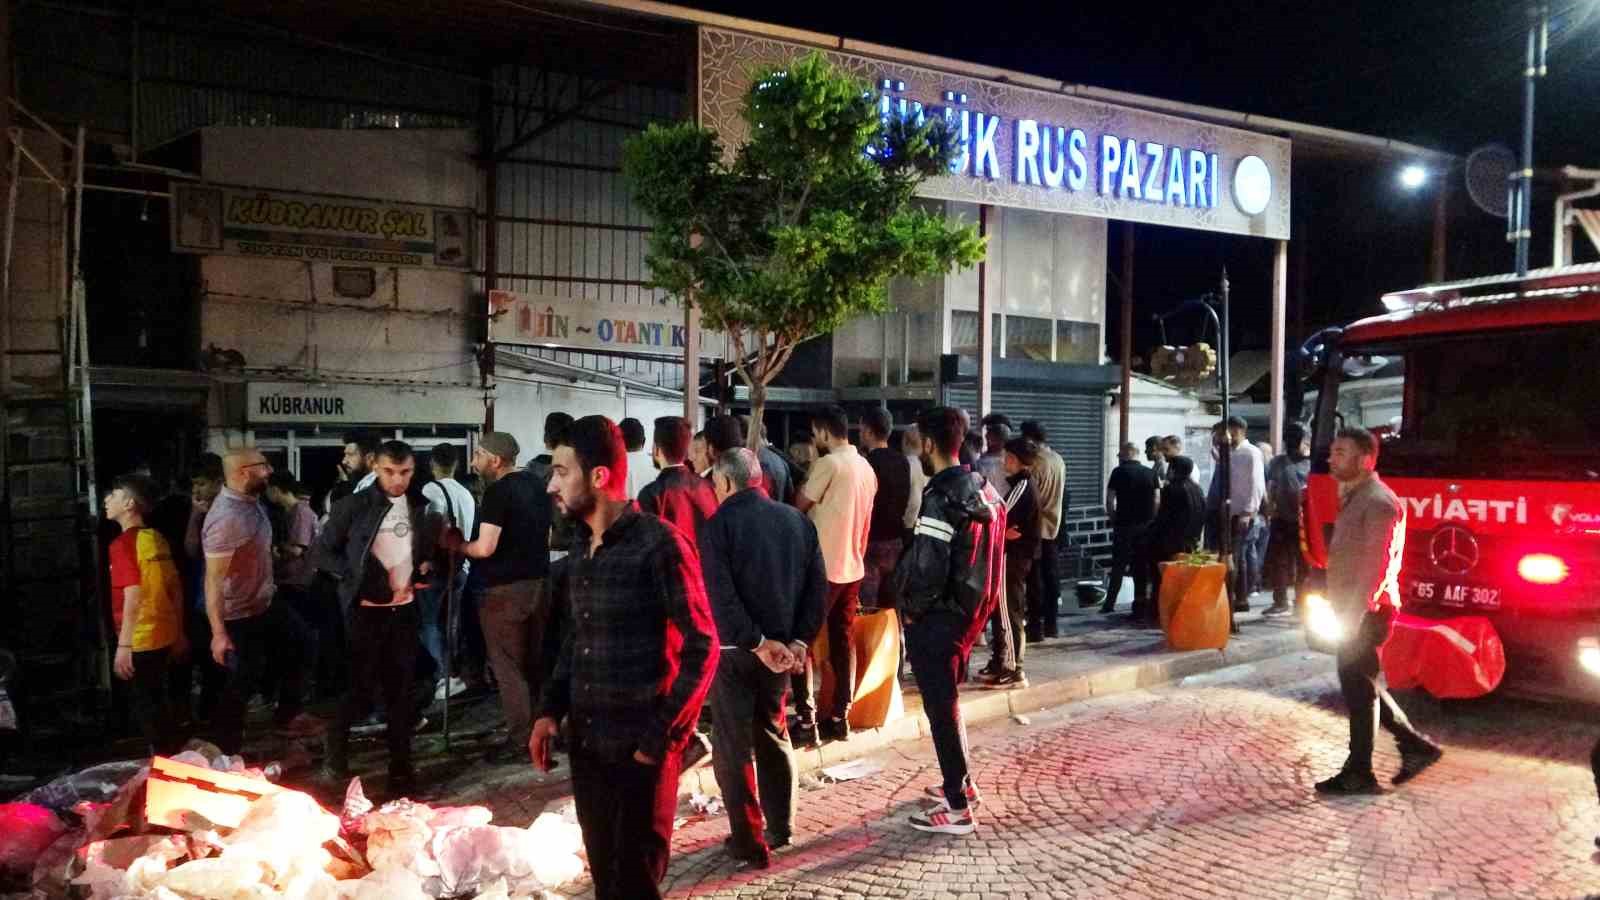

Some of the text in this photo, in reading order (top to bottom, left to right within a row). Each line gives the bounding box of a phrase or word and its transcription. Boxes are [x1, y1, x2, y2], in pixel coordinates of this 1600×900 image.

[1016, 119, 1088, 191] RUS
[1102, 135, 1219, 208] PAZARI
[225, 193, 426, 240] KÜBRANUR ŞAL
[596, 318, 692, 348] OTANTİK
[259, 393, 344, 416] KÜBRANUR
[1417, 582, 1498, 605] 65 AAF 302
